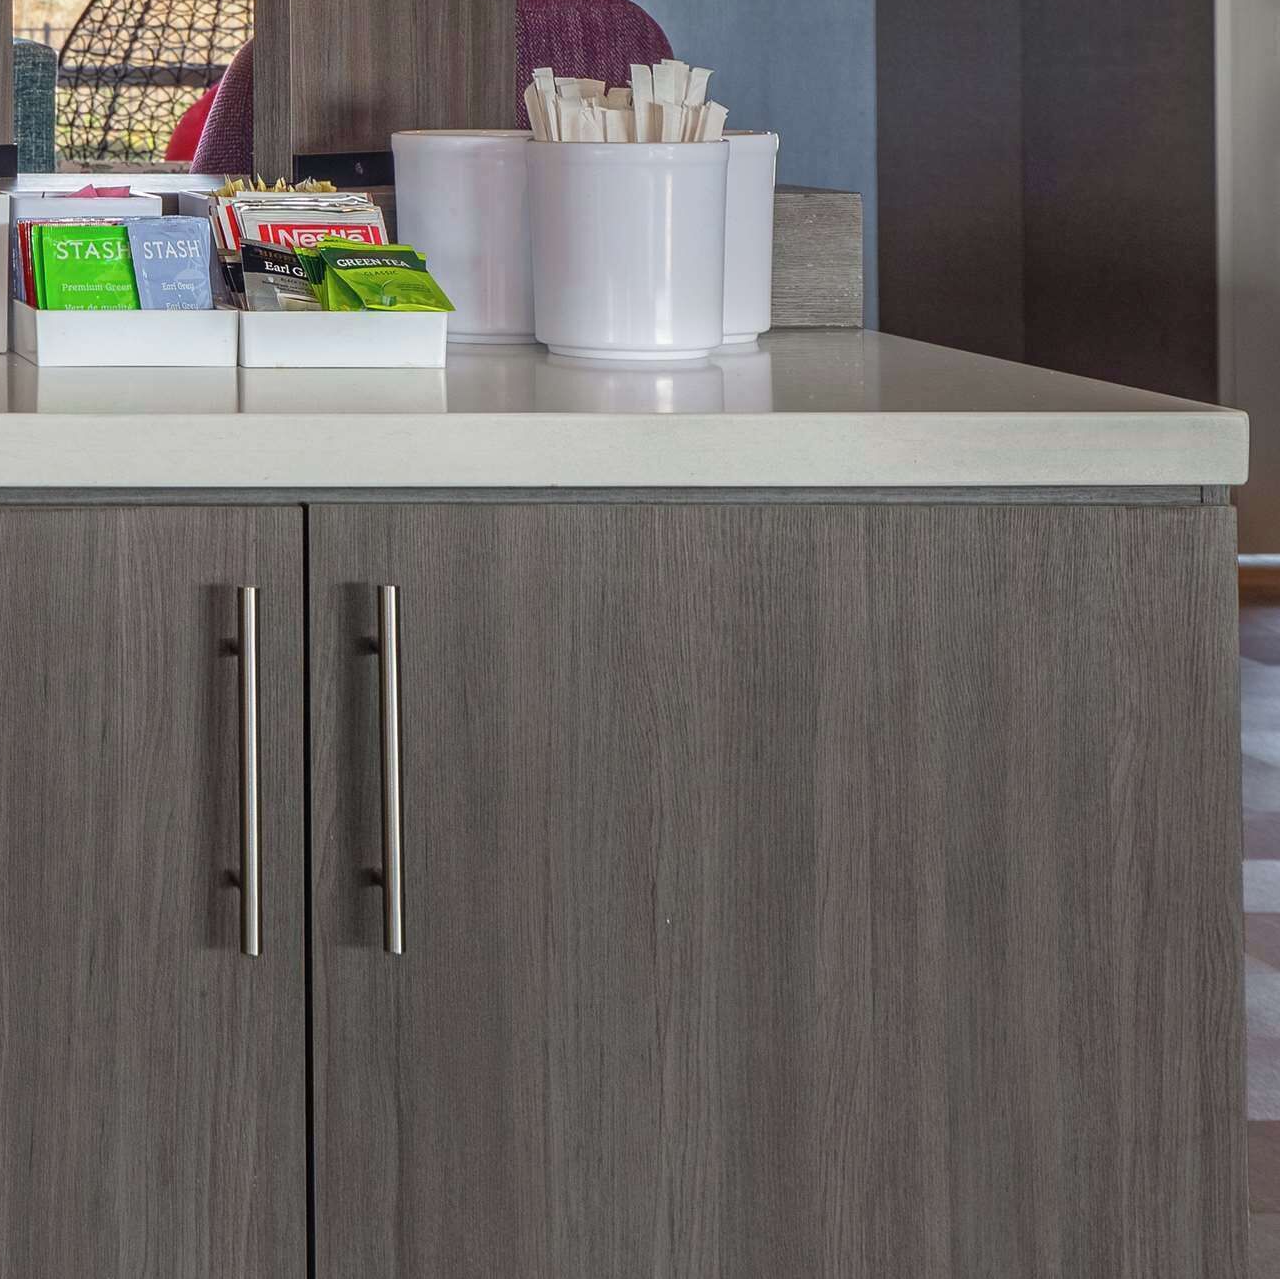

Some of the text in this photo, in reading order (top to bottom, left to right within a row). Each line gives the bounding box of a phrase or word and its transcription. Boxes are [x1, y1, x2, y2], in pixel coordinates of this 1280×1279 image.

[56, 239, 130, 260] STASH
[144, 239, 201, 260] STASH
[265, 261, 290, 274] Earl
[336, 258, 411, 268] GREEN TEA
[62, 282, 132, 291] Premium Green
